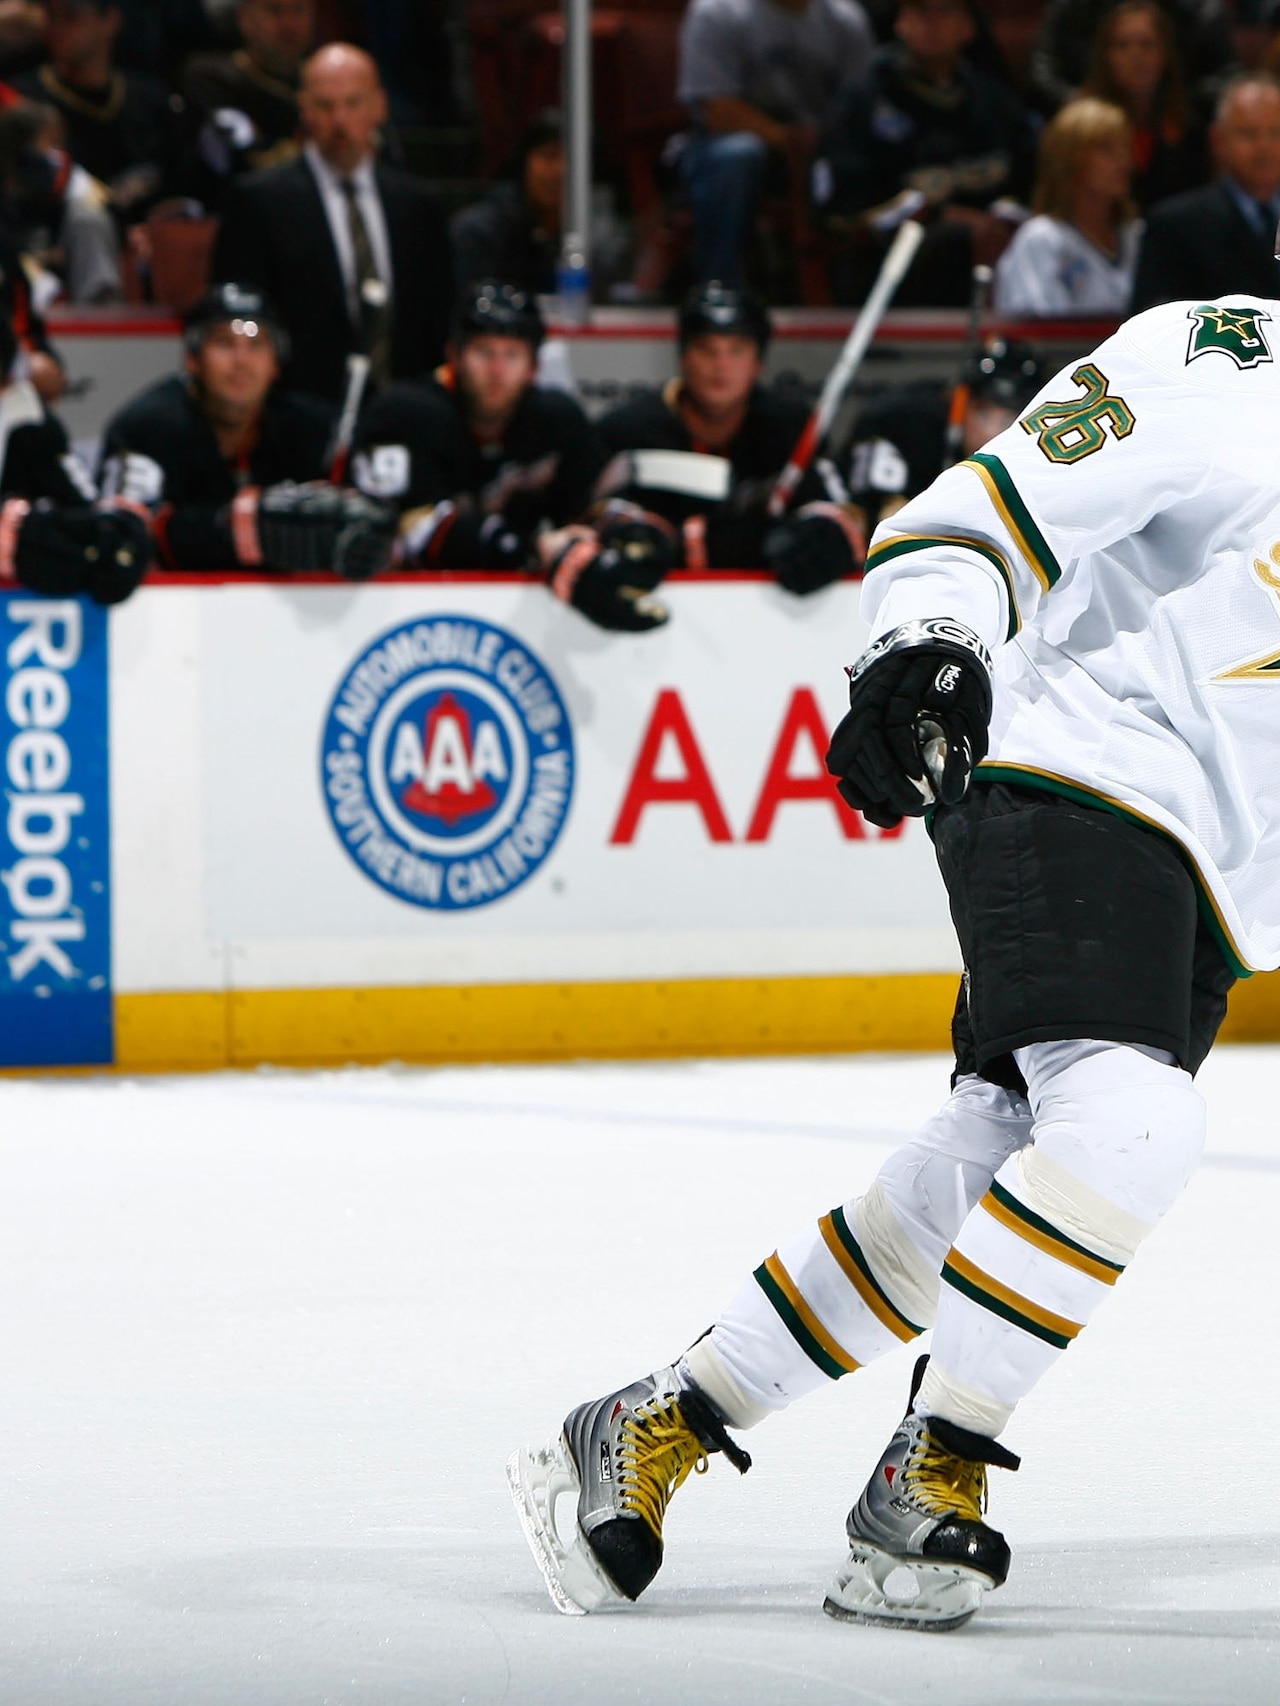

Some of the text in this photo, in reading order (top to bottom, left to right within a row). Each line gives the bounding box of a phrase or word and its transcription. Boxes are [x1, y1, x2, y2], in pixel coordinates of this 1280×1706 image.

[1019, 362, 1136, 465] 26
[335, 620, 562, 736] AUTOMOBILE CLUB
[5, 600, 86, 981] Reebok
[389, 716, 508, 794] AAA
[606, 686, 906, 846] AA
[326, 750, 569, 904] SOUTHERN CALIFORNIA
